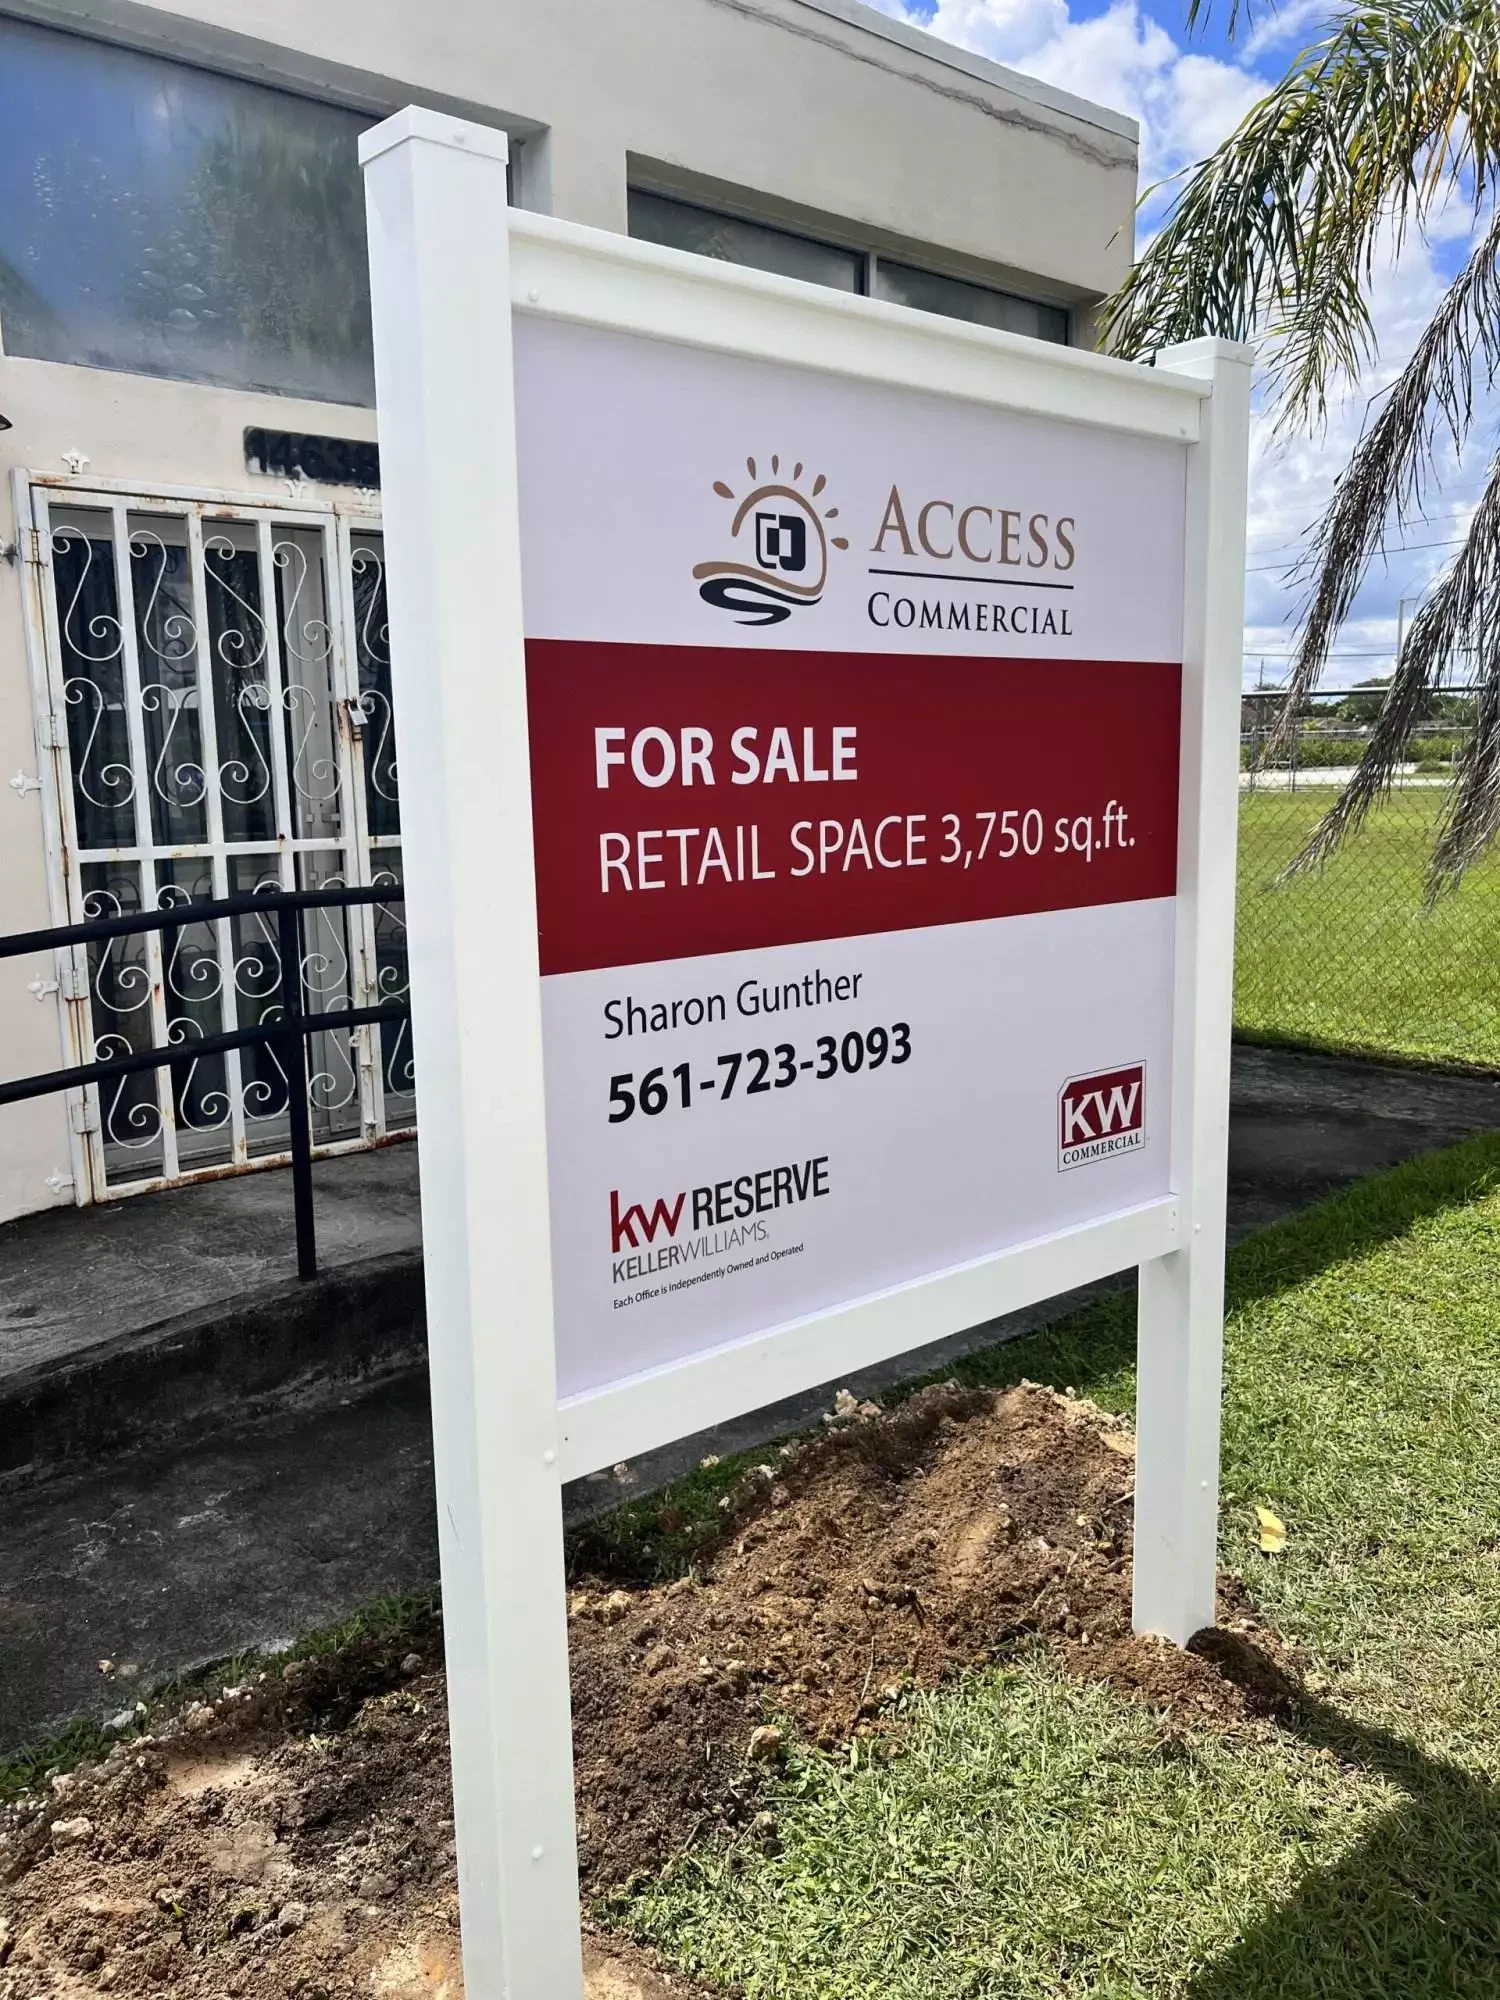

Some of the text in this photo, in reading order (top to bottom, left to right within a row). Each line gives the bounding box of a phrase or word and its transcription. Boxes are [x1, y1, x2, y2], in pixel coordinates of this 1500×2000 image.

[869, 484, 1076, 572] ACCESS
[867, 591, 1074, 636] COMMERCIAL
[594, 726, 858, 789] FOR SALE
[600, 799, 1136, 893] RETAIL SPACE 3,750 sq.ft.
[604, 968, 863, 1039] Sharon Gunther
[608, 1022, 912, 1123] 561-723-3093
[1063, 1081, 1141, 1144] KW
[1063, 1132, 1141, 1165] COMMERCIAL
[609, 1155, 830, 1253] kw RESERVE
[613, 1242, 804, 1309] Each Office is Independently Owned and Operated
